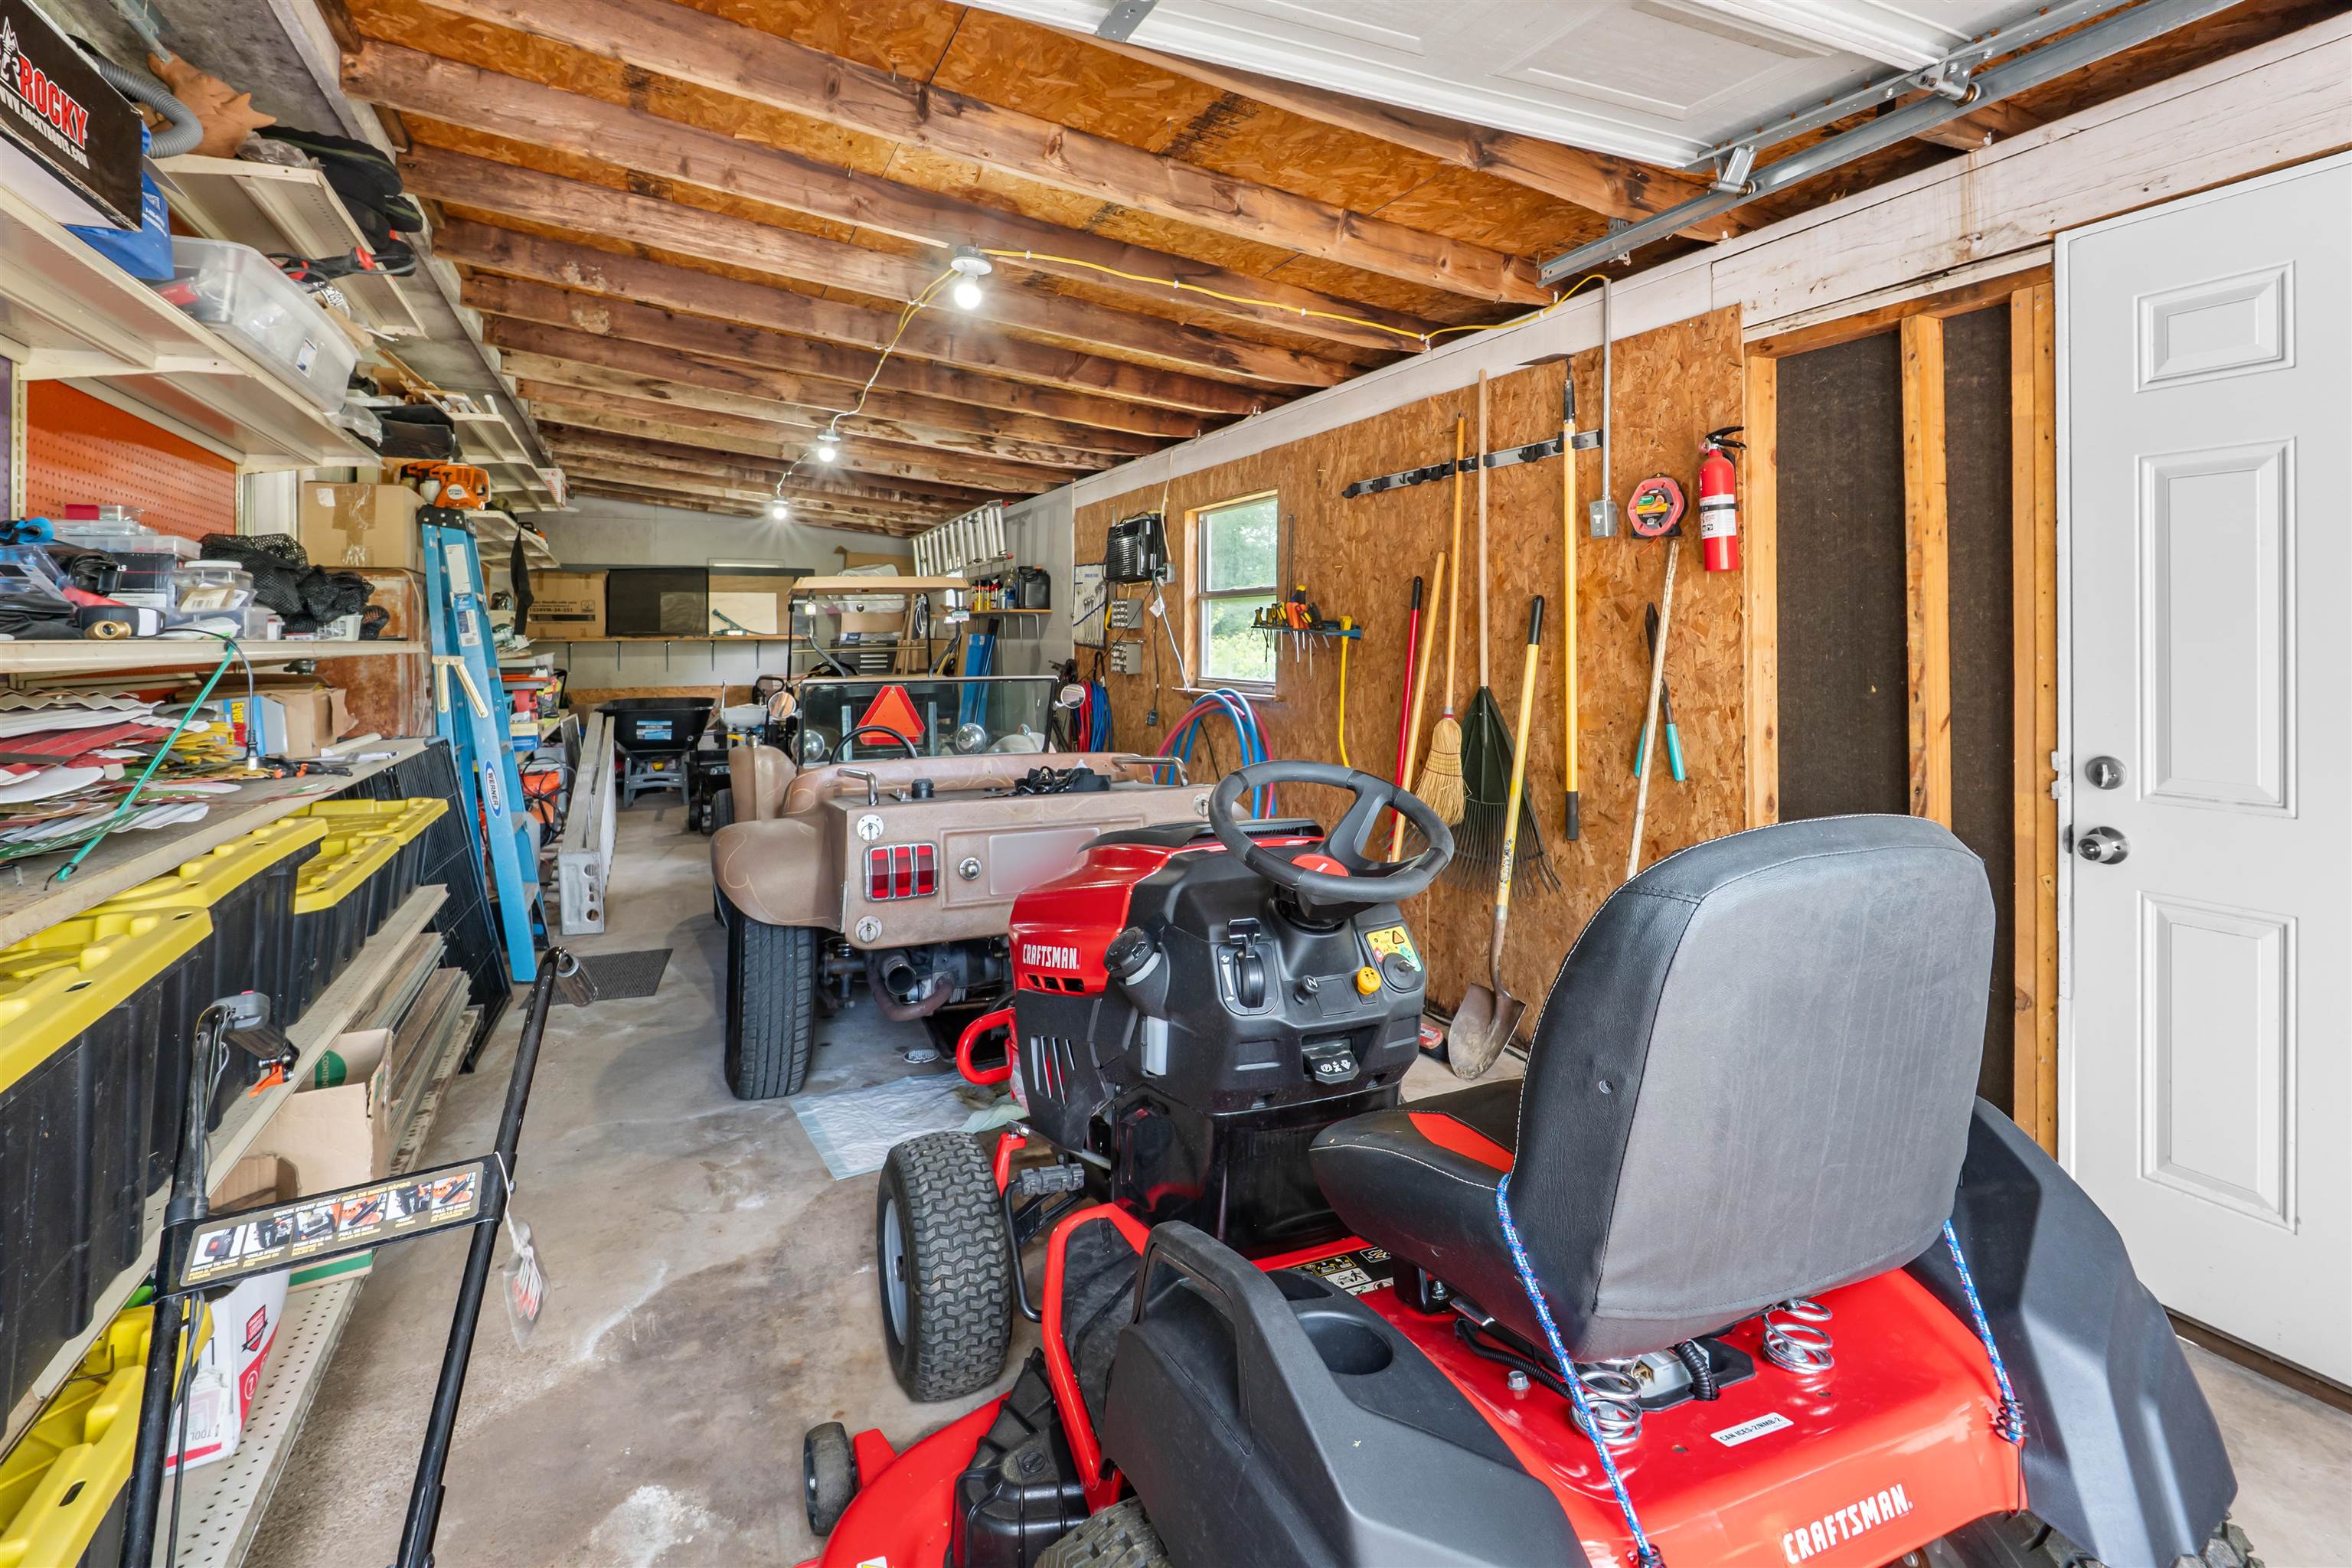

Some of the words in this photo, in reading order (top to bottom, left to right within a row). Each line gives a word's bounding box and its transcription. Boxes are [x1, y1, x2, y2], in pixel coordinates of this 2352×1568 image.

[18, 53, 88, 149] ROCKY
[488, 772, 499, 806] WERNER
[1023, 943, 1078, 970] CRAFTSMAN
[273, 1207, 294, 1217] QUICK
[295, 1203, 316, 1212] START
[317, 1197, 336, 1207] GUIDE
[190, 1429, 211, 1441] TOOL
[1720, 1433, 1736, 1442] CAN
